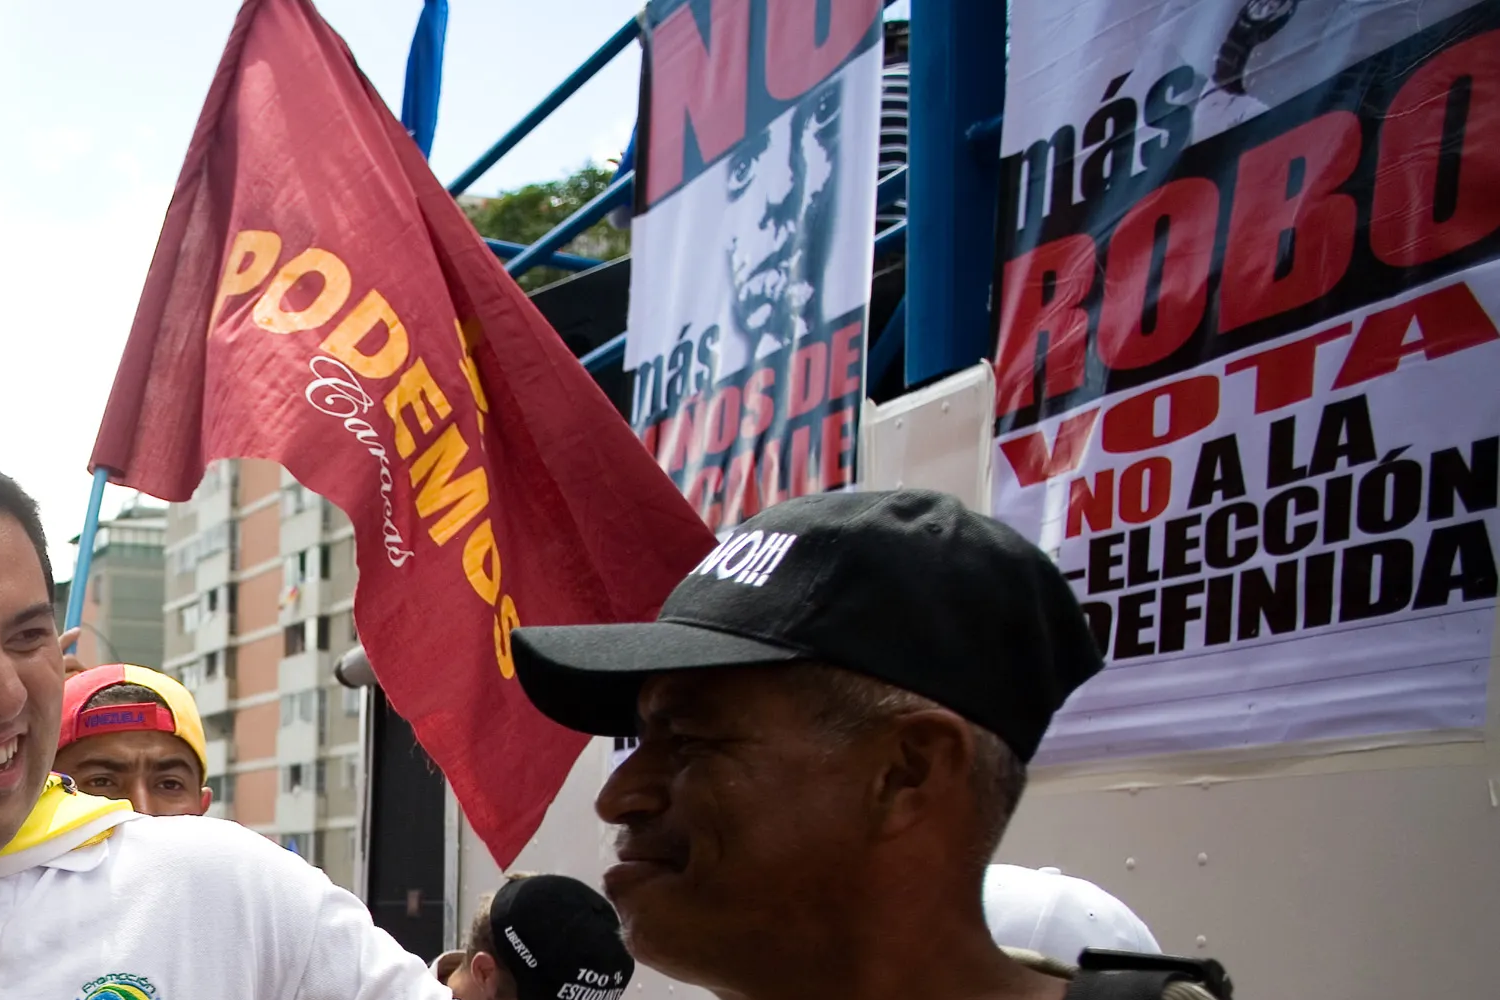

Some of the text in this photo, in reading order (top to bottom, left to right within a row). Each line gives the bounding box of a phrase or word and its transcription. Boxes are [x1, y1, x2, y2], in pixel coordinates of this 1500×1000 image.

[996, 29, 1500, 416] ROBO
[1017, 70, 1196, 231] más
[631, 322, 721, 425] más
[787, 321, 862, 420] DE
[1000, 281, 1499, 488] VOTA
[208, 230, 521, 679] PODEMOS
[305, 355, 415, 569] Caracas
[1065, 394, 1377, 540] NO A LA
[504, 925, 538, 969] LIBERTAD
[577, 968, 609, 987] 100
